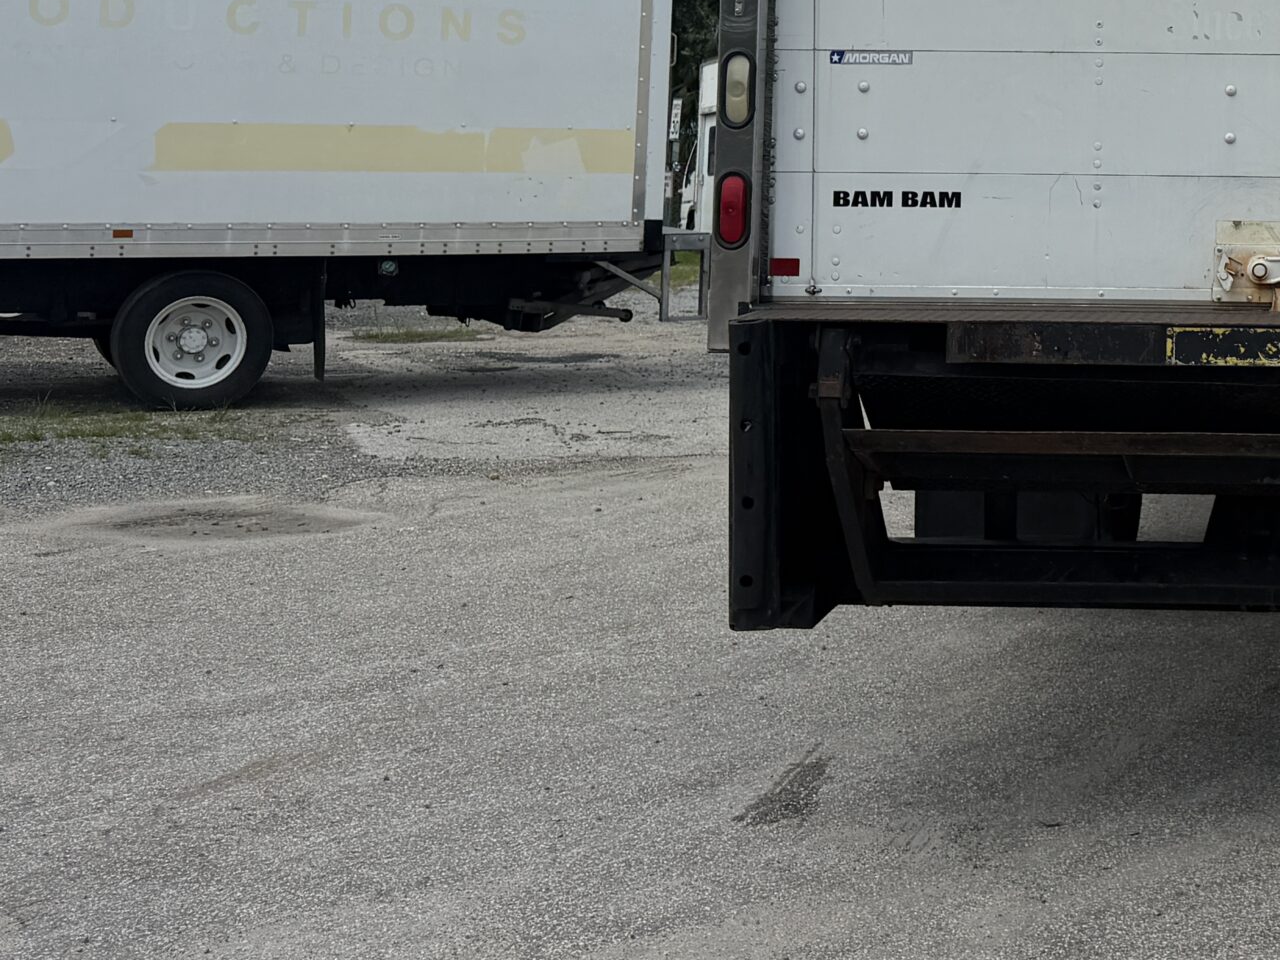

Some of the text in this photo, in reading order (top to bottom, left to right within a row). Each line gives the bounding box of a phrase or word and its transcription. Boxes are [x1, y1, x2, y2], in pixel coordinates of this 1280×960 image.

[842, 53, 910, 64] MORGAN
[832, 190, 962, 208] BAM BAM
